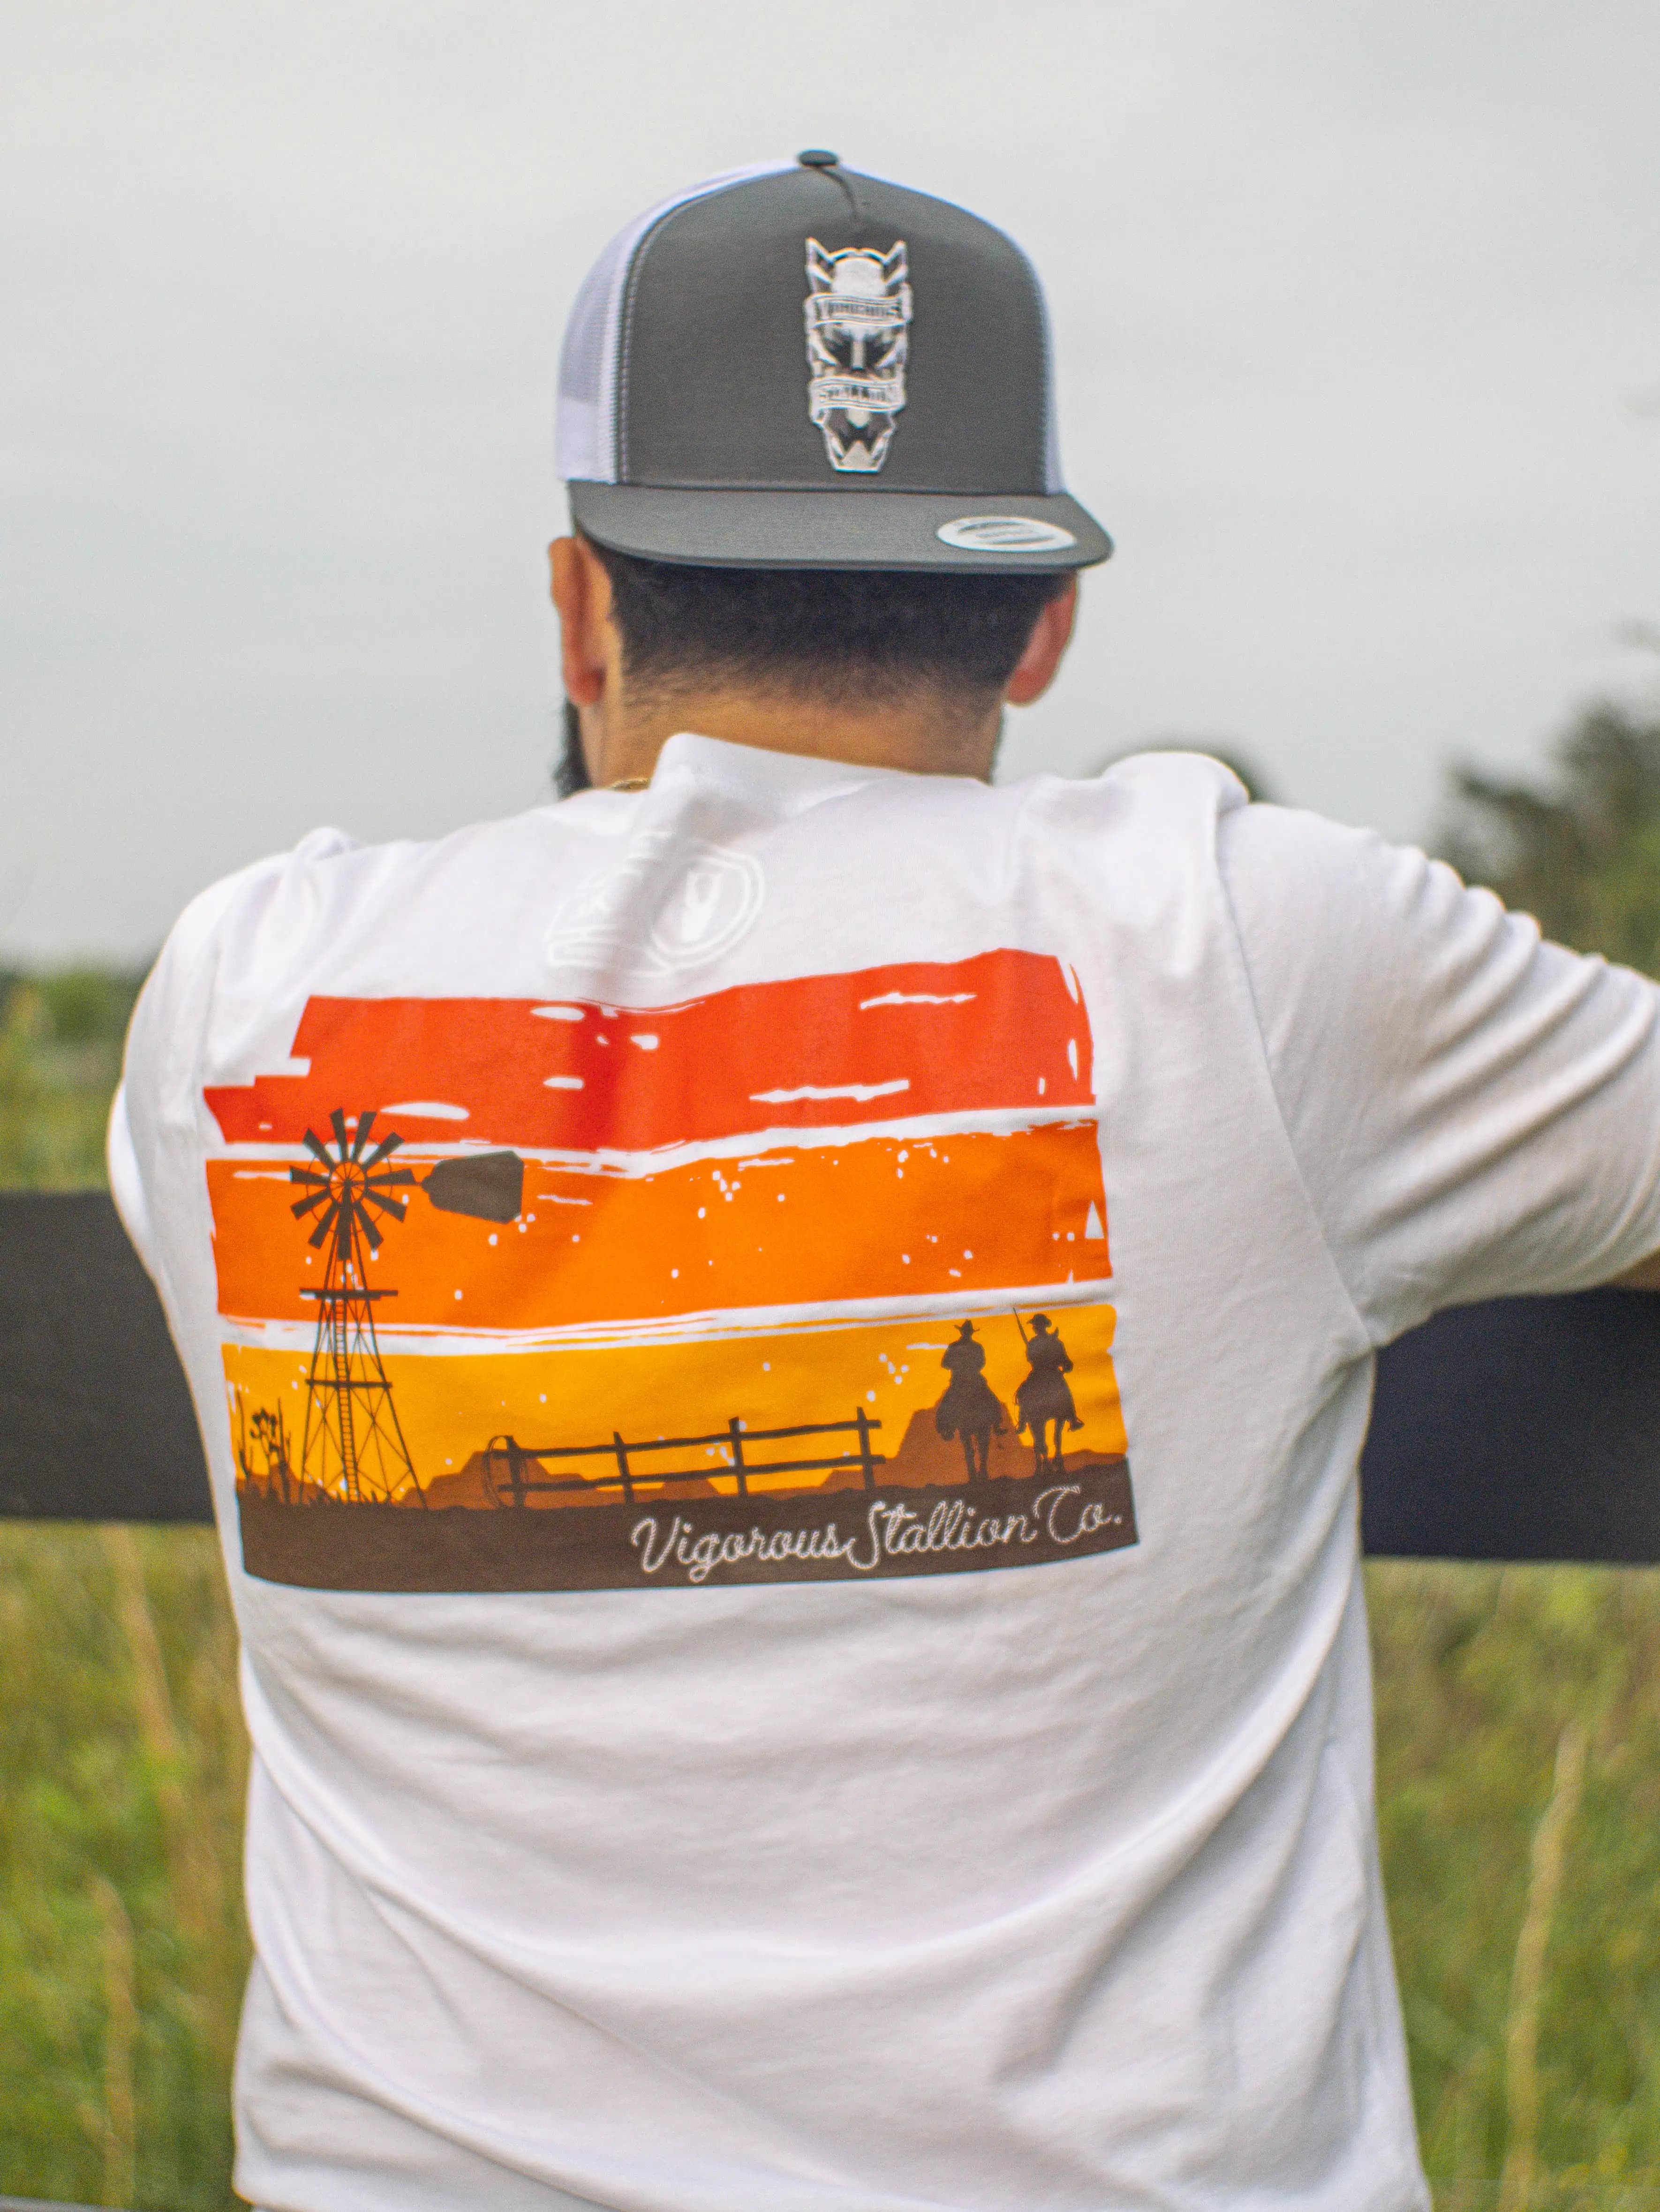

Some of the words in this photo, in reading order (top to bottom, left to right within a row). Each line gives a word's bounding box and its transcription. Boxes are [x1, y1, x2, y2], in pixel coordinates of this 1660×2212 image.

[631, 1515, 848, 1583] Vigorous
[845, 1500, 1037, 1569] Stallion
[1033, 1486, 1123, 1543] Co.
